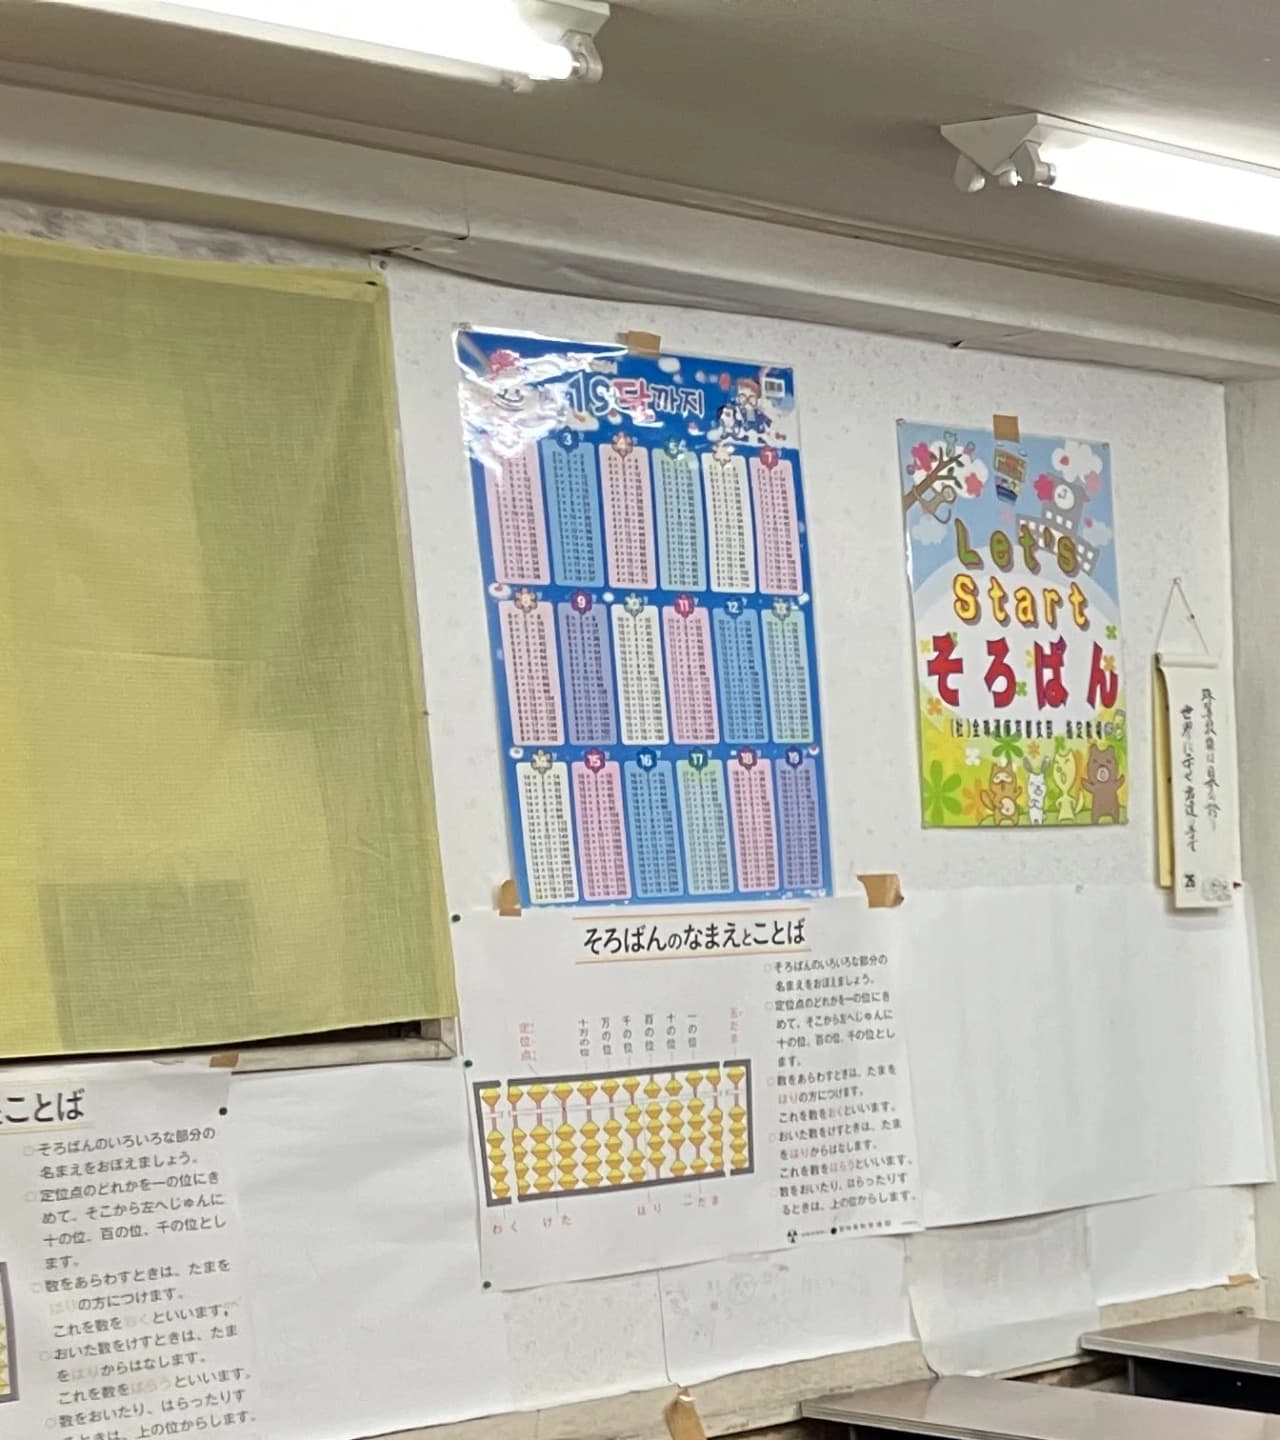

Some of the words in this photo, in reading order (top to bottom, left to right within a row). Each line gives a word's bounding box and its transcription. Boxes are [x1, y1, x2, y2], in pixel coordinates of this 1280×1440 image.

[955, 518, 1078, 576] Let's
[953, 573, 1088, 629] Start
[927, 633, 1119, 711] そろばん
[584, 918, 806, 955] そろばんのなまえとことば
[0, 1088, 85, 1125] ことば
[39, 1127, 216, 1157] そろばんのいろいろな部分の
[40, 1171, 219, 1203] 定位点のどれかを一の位にき
